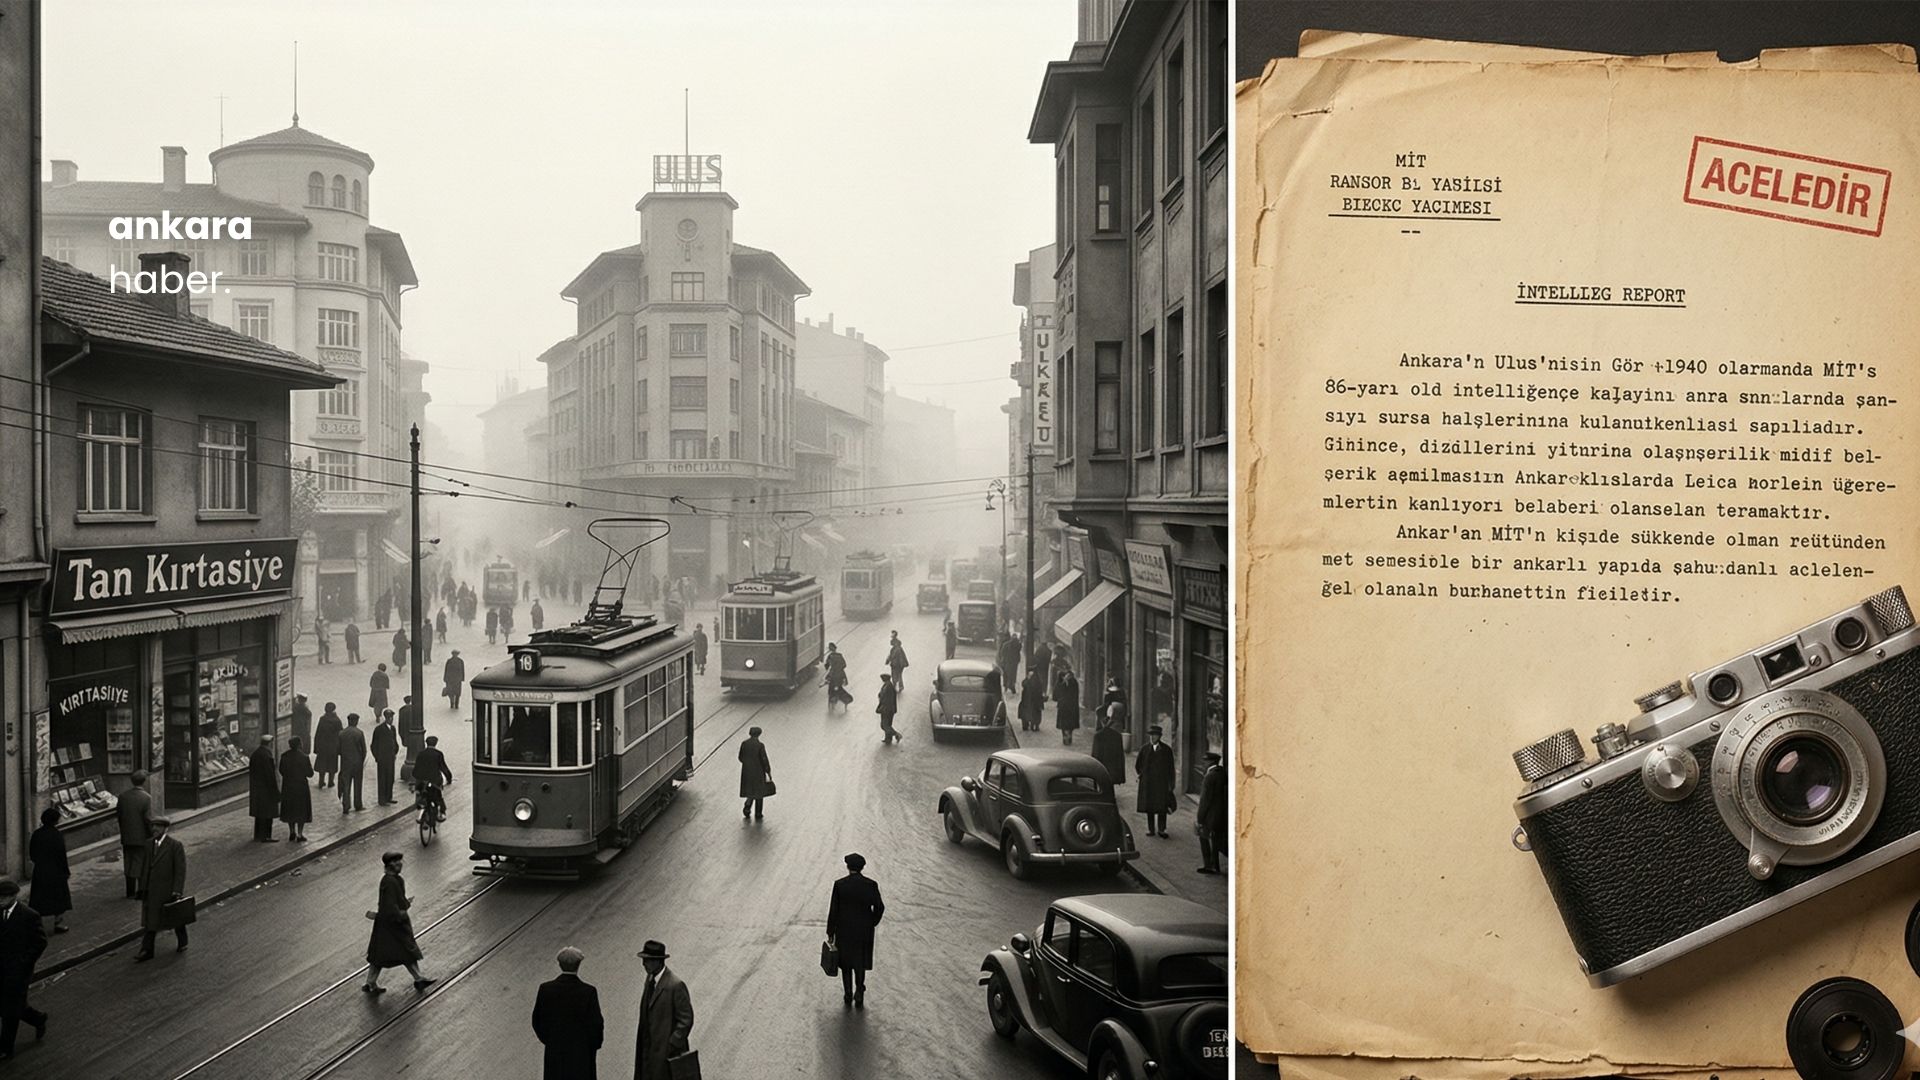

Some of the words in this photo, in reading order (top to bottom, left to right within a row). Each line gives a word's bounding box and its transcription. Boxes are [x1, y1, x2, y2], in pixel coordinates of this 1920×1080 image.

[656, 155, 722, 182] ULUS
[1395, 151, 1427, 168] MİT
[1330, 175, 1392, 190] RANSOR
[1700, 157, 1872, 218] ACELEDİR
[1412, 200, 1492, 215] YACIMESI
[1622, 287, 1686, 303] REPORT
[1399, 352, 1485, 369] Ankara'n
[1494, 354, 1602, 372] Ulus'nisin
[1611, 357, 1645, 373] Gör
[1718, 360, 1814, 377] olarmanda
[1822, 359, 1877, 379] MİT's
[1325, 378, 1399, 399] 86-yarı
[1410, 381, 1443, 397] old
[1685, 391, 1729, 404] anra
[1855, 395, 1898, 410] şan-
[1325, 411, 1367, 427] sıyı
[1378, 412, 1431, 425] sursa
[1779, 447, 1833, 463] midif
[1843, 448, 1882, 464] bel-
[1324, 465, 1377, 483] şerik
[1684, 473, 1738, 489] Leica
[1322, 494, 1398, 510] mlertin
[1514, 497, 1600, 515] belaberi
[1609, 500, 1706, 517] olanselan
[1716, 502, 1830, 520] teramaktır.
[1395, 524, 1483, 541] Ankar'an
[1491, 523, 1546, 542] MİT'n
[1630, 529, 1715, 546] sükkende
[1726, 531, 1780, 548] olman
[1789, 533, 1886, 550] reütünden
[68, 558, 133, 601] Tan
[145, 549, 284, 591] Kırtasiye
[1321, 551, 1354, 567] met
[1471, 554, 1503, 570] bir
[1513, 556, 1588, 572] ankarlı
[1597, 558, 1662, 576] yapıda
[1789, 562, 1875, 578] aclelen-
[1321, 579, 1353, 598] ğel
[1364, 581, 1439, 598] olanaln
[1449, 583, 1567, 600] burhanettin
